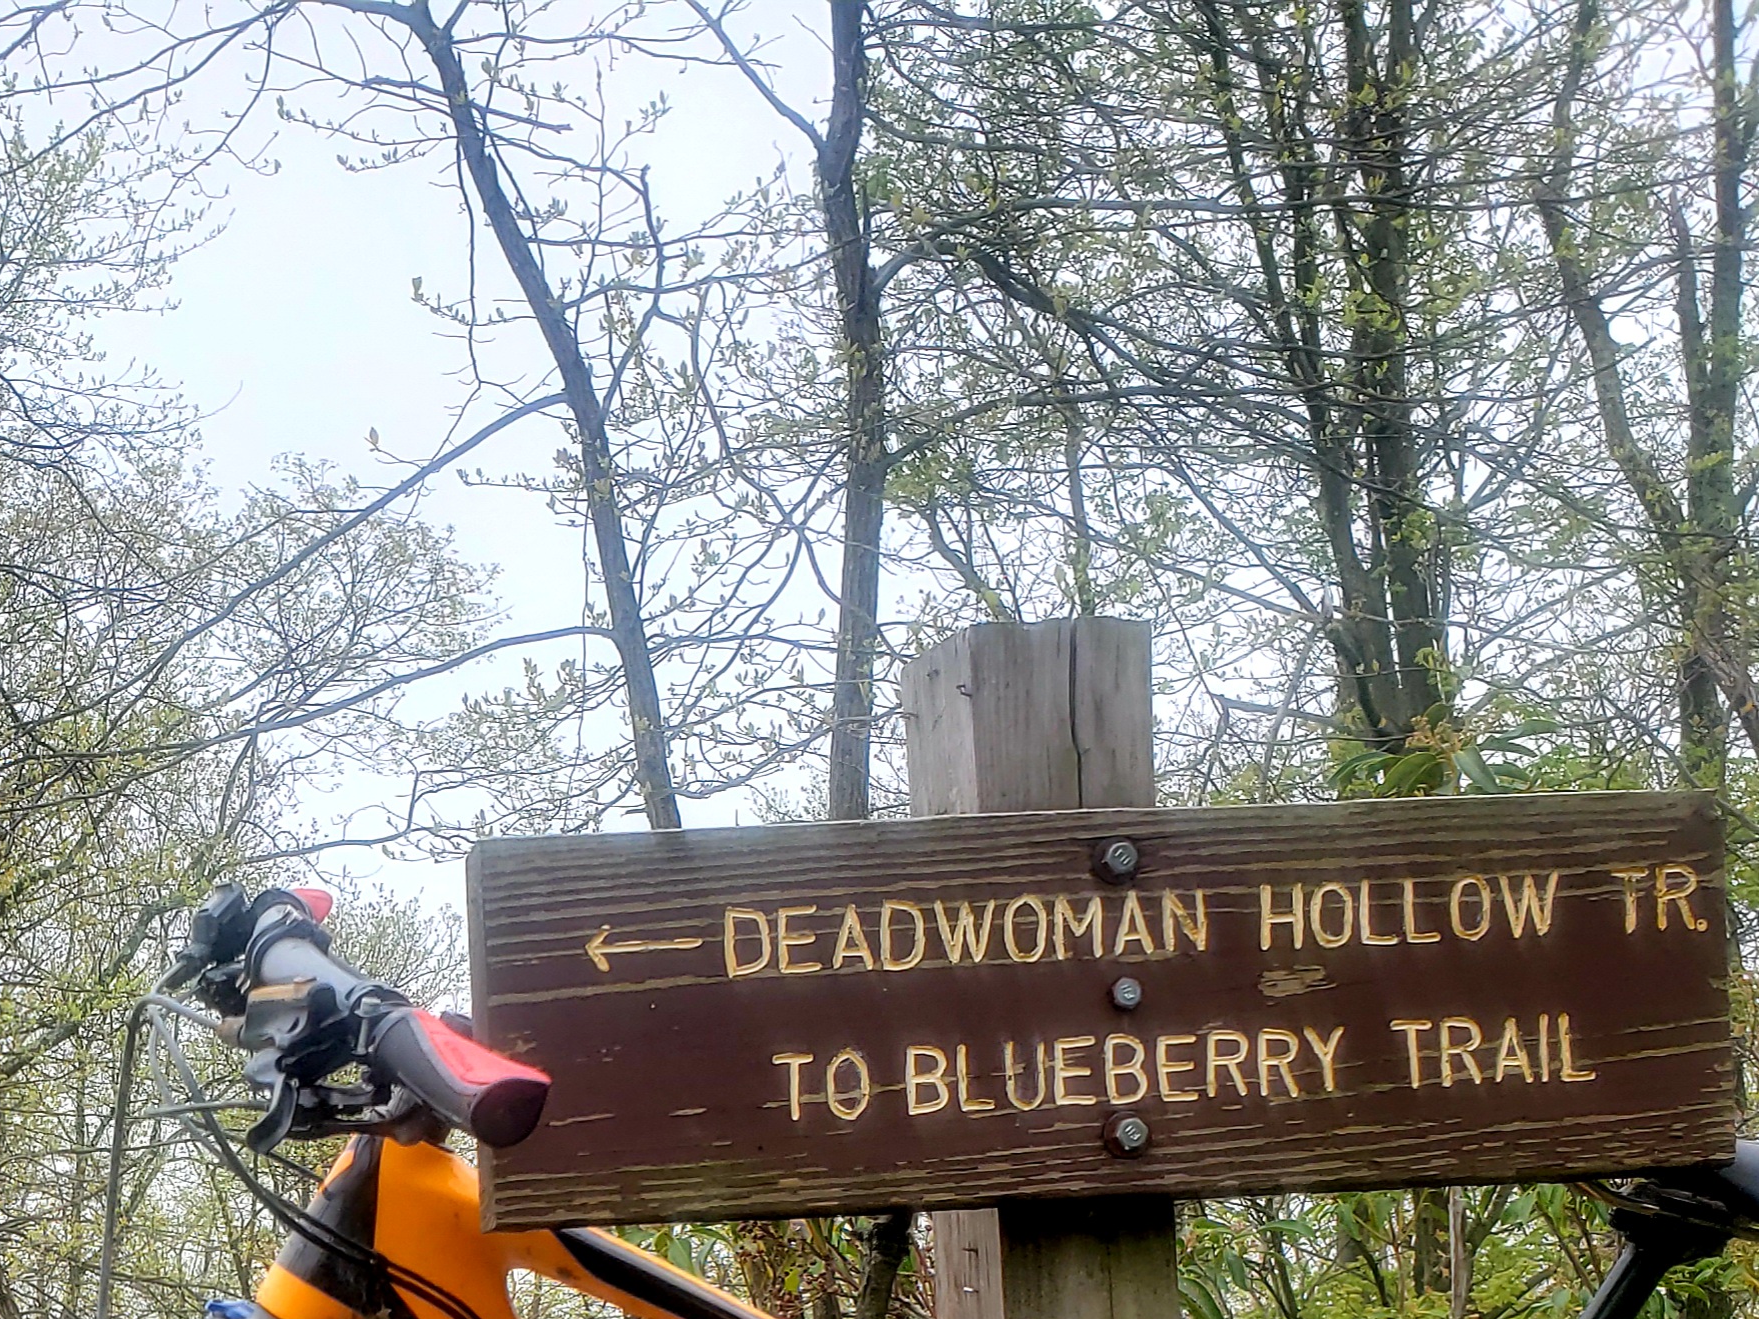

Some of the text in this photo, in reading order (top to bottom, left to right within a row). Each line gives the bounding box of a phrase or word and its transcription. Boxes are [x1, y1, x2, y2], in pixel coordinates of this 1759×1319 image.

[724, 862, 1709, 979] DEADWOMAN HOLLOW TR.
[772, 1011, 1597, 1121] TO BLUEBERRY TRAIL
